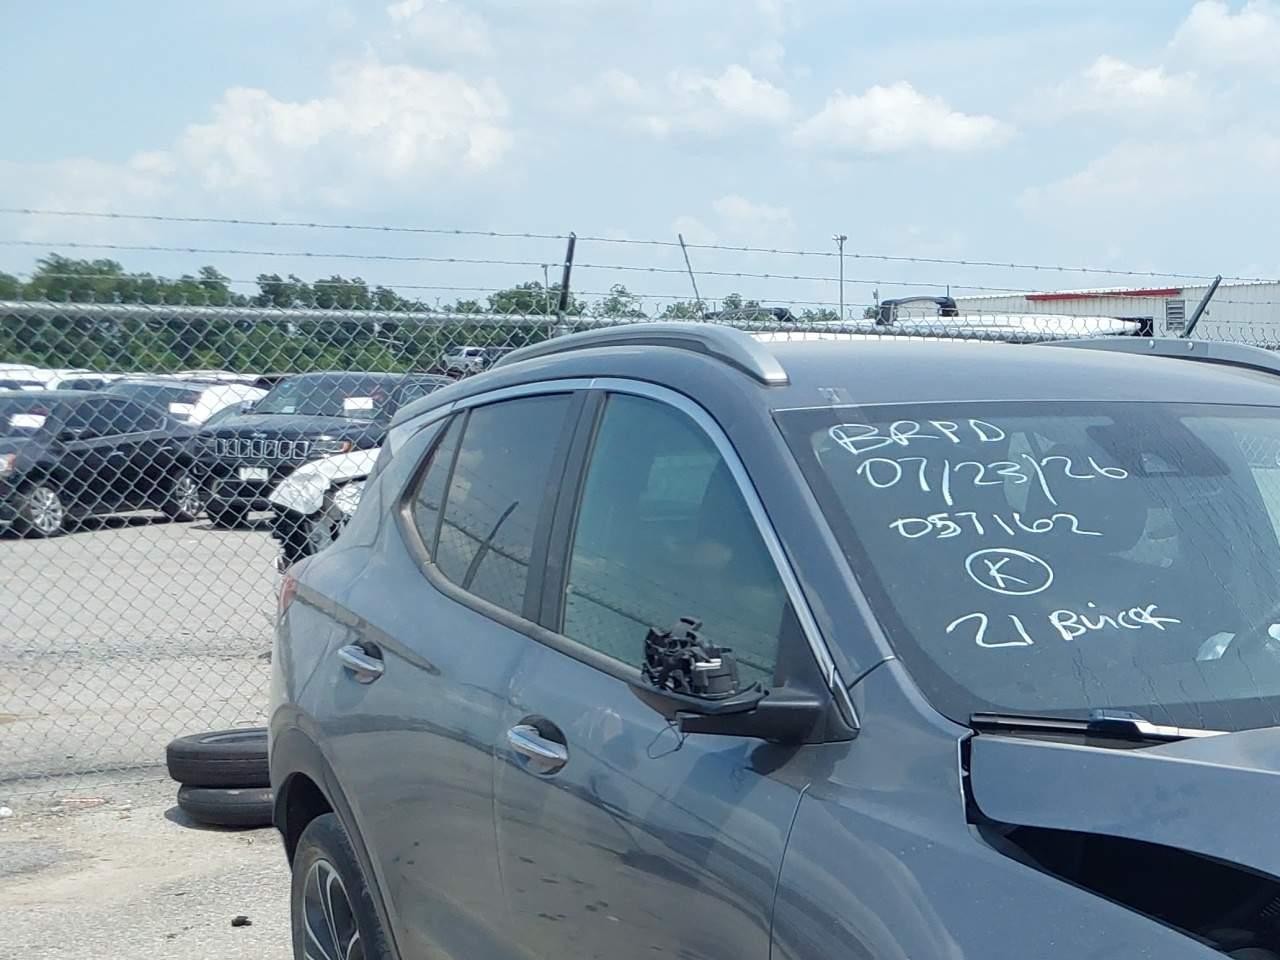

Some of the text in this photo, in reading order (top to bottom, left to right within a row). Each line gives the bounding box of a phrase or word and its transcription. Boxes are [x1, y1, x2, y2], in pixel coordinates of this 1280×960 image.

[829, 420, 1006, 454] BRPD
[856, 453, 1129, 506] 07/23/26
[945, 612, 1034, 648] 21
